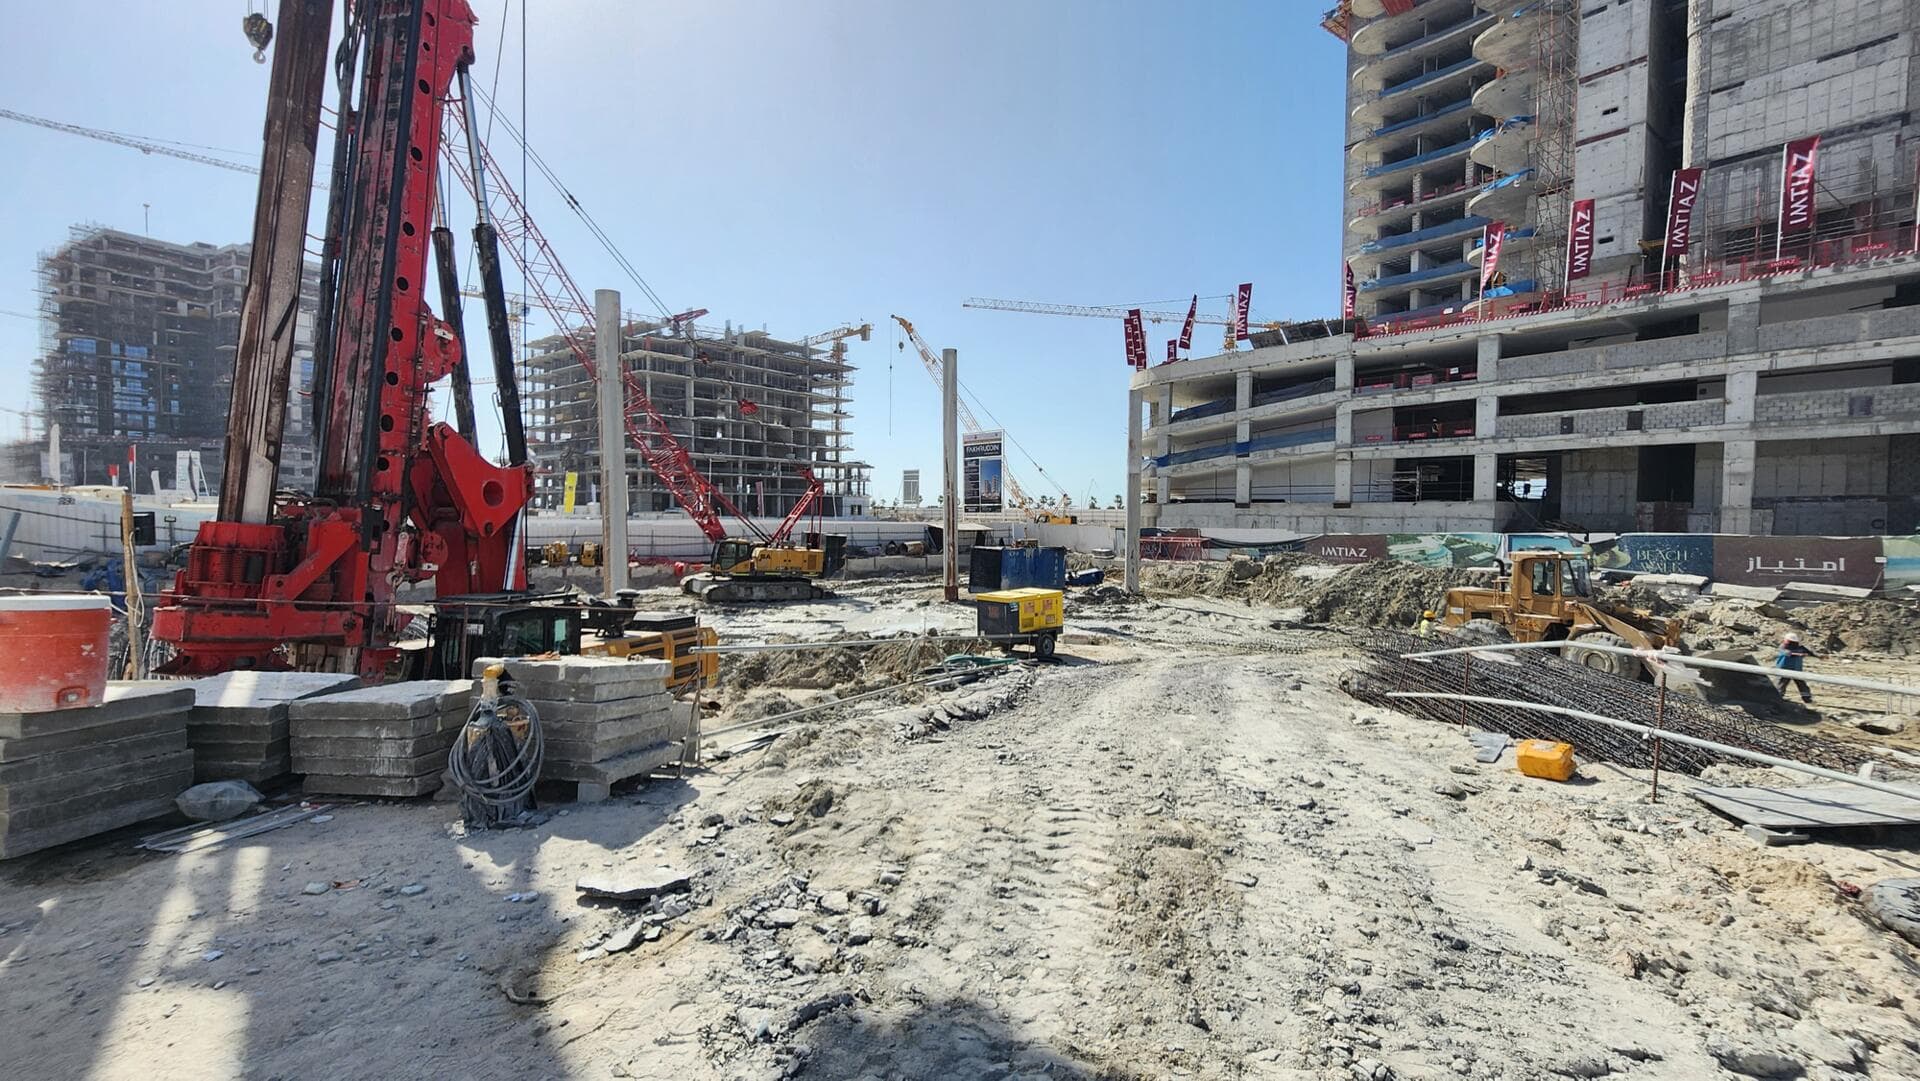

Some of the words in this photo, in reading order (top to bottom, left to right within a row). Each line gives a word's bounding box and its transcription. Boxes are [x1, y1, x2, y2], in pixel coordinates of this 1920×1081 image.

[1789, 150, 1814, 224] IMTIAZ
[1672, 179, 1698, 247] IMTIAZ
[1573, 209, 1590, 273] IMTIAZ
[1238, 290, 1250, 336] IMTIAZ
[1321, 546, 1368, 558] IMTIAZ
[1636, 550, 1688, 561] BEACH
[1746, 556, 1845, 573] امتياز
